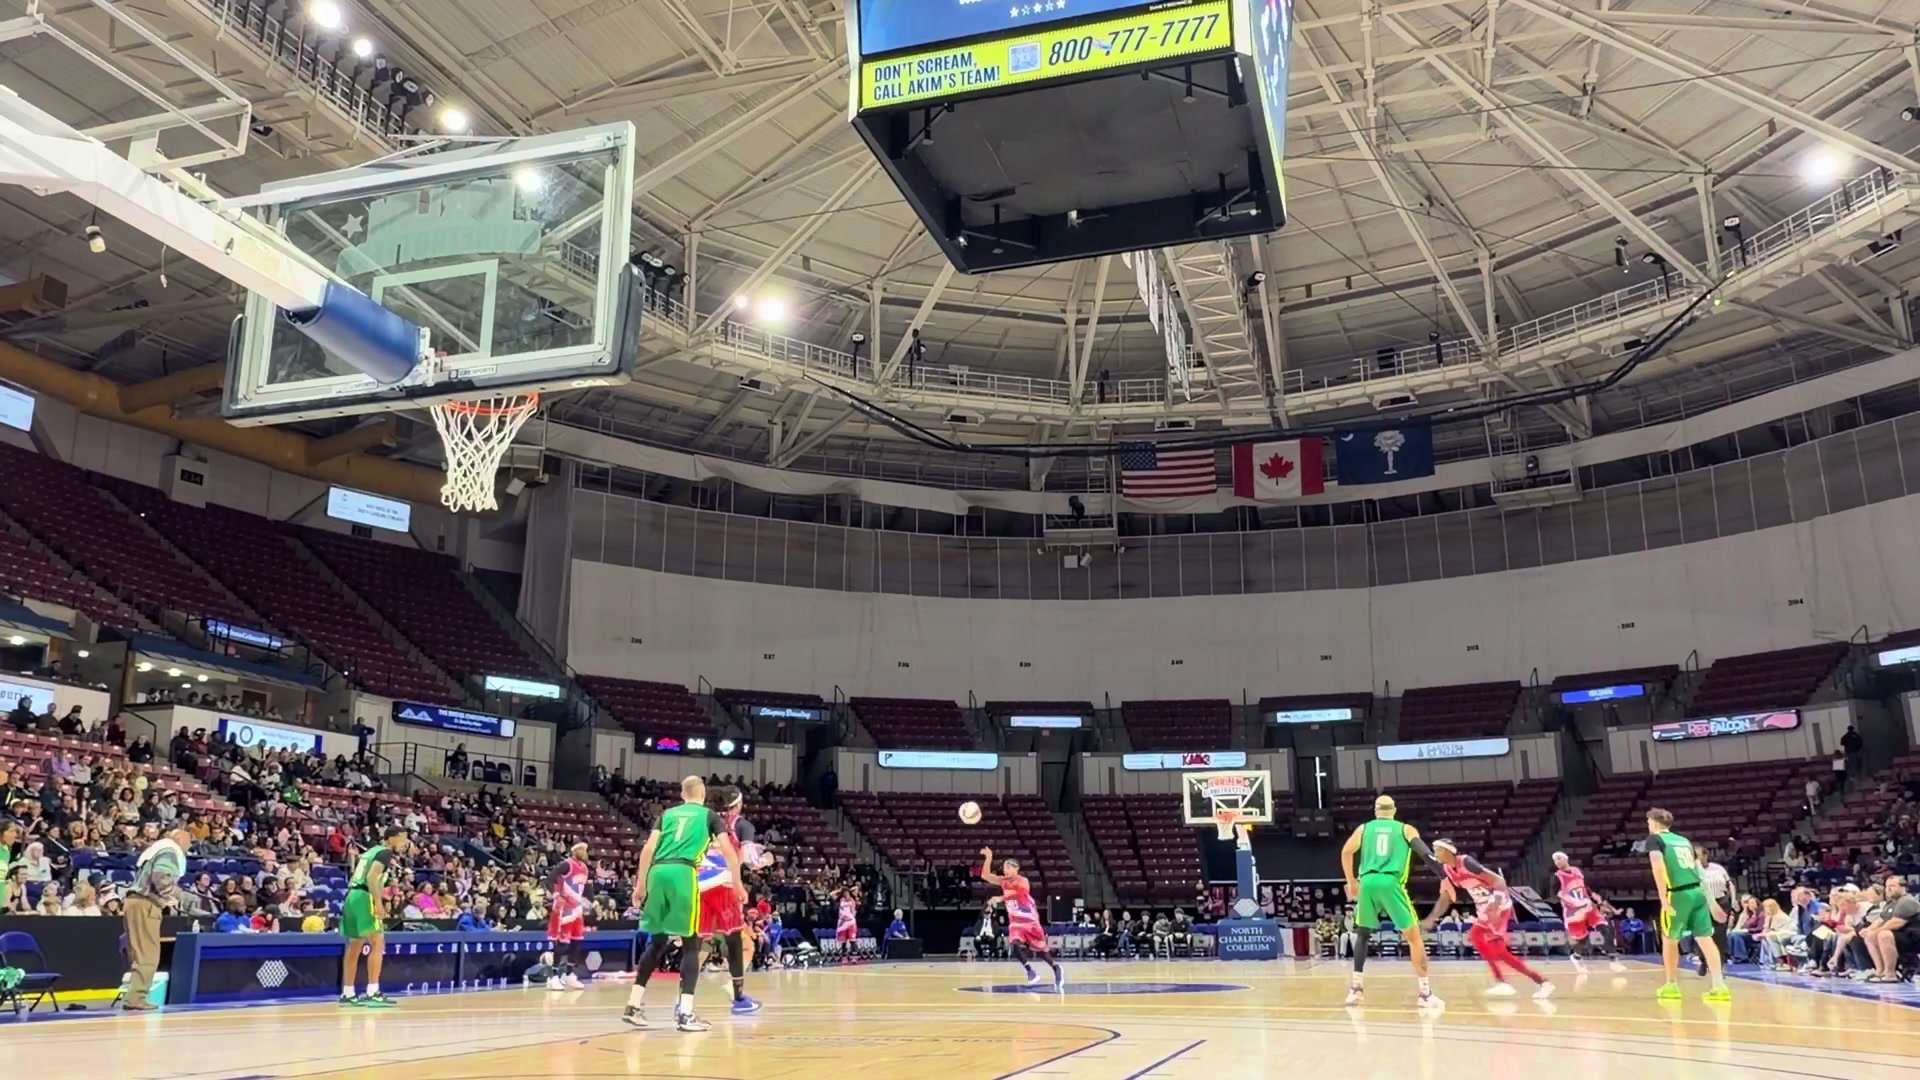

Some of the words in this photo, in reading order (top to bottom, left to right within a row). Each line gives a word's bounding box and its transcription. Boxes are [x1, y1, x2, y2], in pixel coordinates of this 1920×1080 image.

[874, 62, 913, 83] DON'T
[917, 51, 978, 74] SCREAM,
[873, 84, 905, 101] CALL
[907, 73, 957, 95] AKIM'S
[960, 65, 1001, 85] TEAM!
[1376, 834, 1388, 857] 0
[1231, 927, 1263, 935] NORTH
[1219, 935, 1276, 944] CHARLESTON
[1226, 943, 1270, 952] COLISEUM
